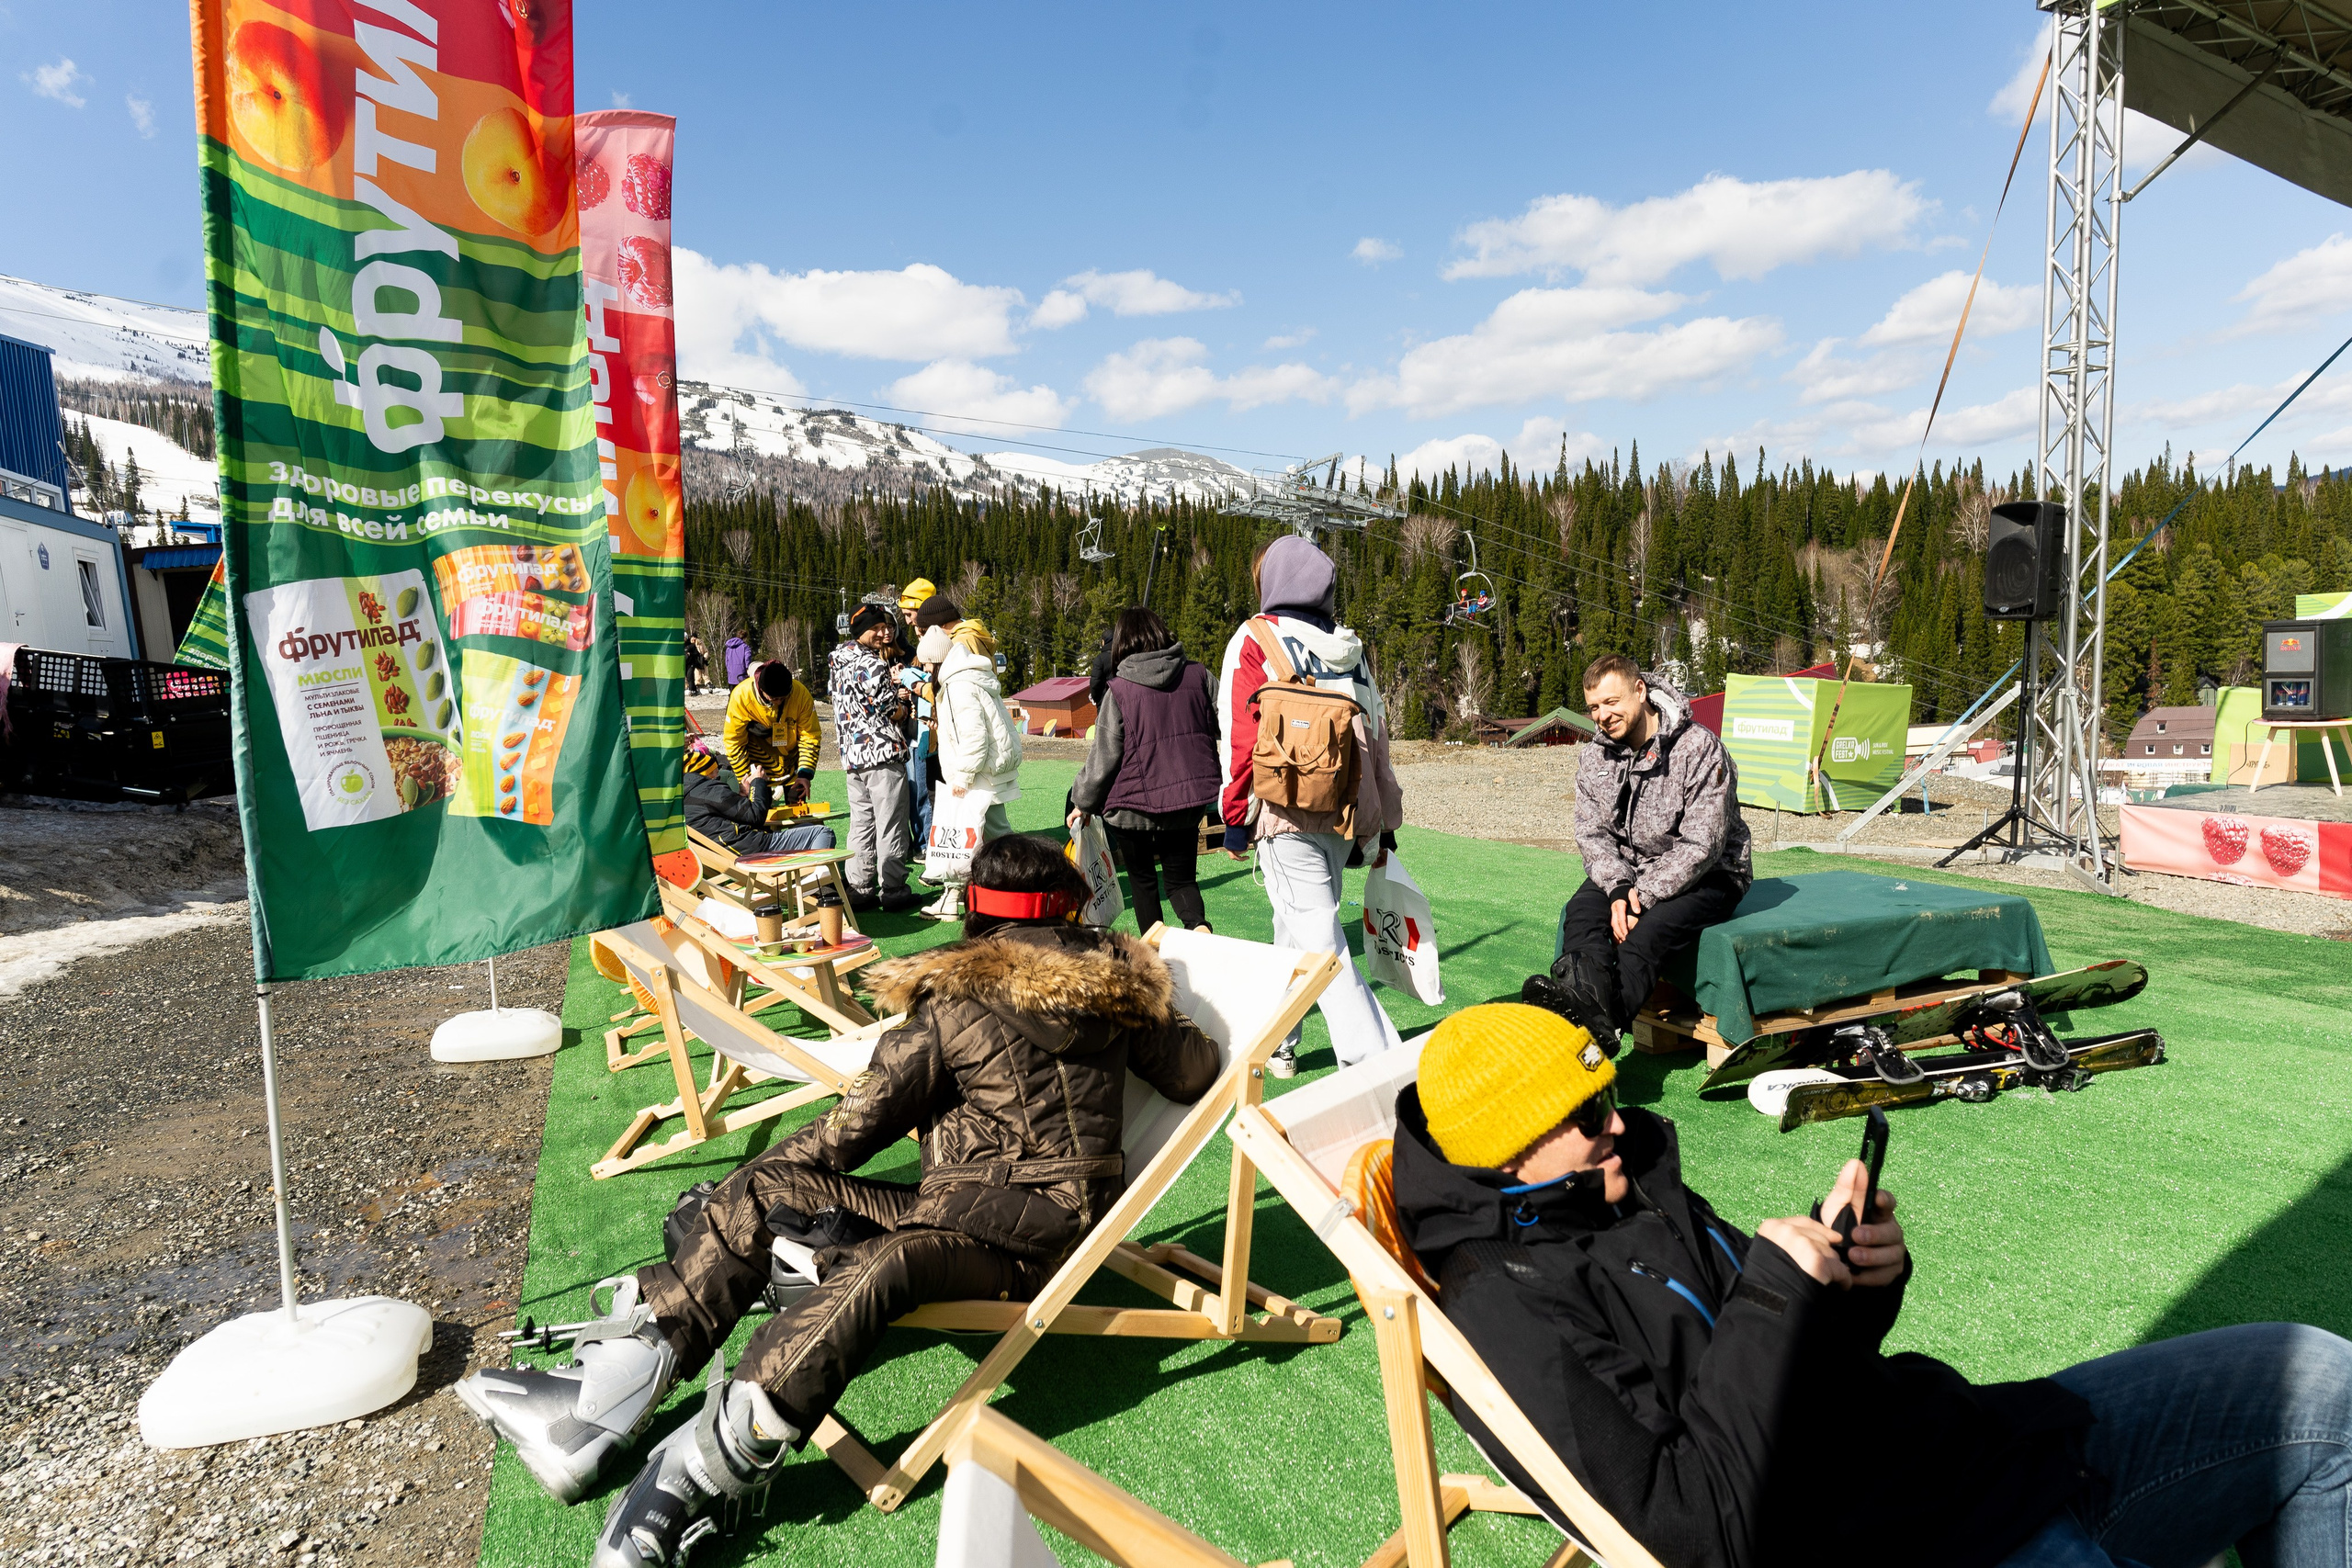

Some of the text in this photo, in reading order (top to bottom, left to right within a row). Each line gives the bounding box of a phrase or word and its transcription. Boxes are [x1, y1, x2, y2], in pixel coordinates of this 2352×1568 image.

[268, 461, 593, 515] здоровые перекусы
[336, 513, 407, 540] всей
[416, 507, 509, 536] семьи
[304, 688, 360, 701] МУЛЬТИЗЛАКОВЫЕ
[313, 698, 356, 710] СЕМЕНАМИ
[310, 710, 333, 719] ЛЬНА
[341, 705, 365, 714] ТЫКВЫ
[313, 720, 362, 732] ПРОРОЩЕННАЯ
[315, 731, 350, 740] ПШЕНИЦА
[346, 736, 368, 744] ГРЕЧКА
[326, 748, 353, 756] ЯЧМЕНЬ
[1836, 750, 1849, 759] FEST
[337, 796, 349, 805] БЕЗ
[937, 826, 963, 849] R
[931, 851, 970, 860] ROSTIC'S
[1376, 908, 1403, 948] R
